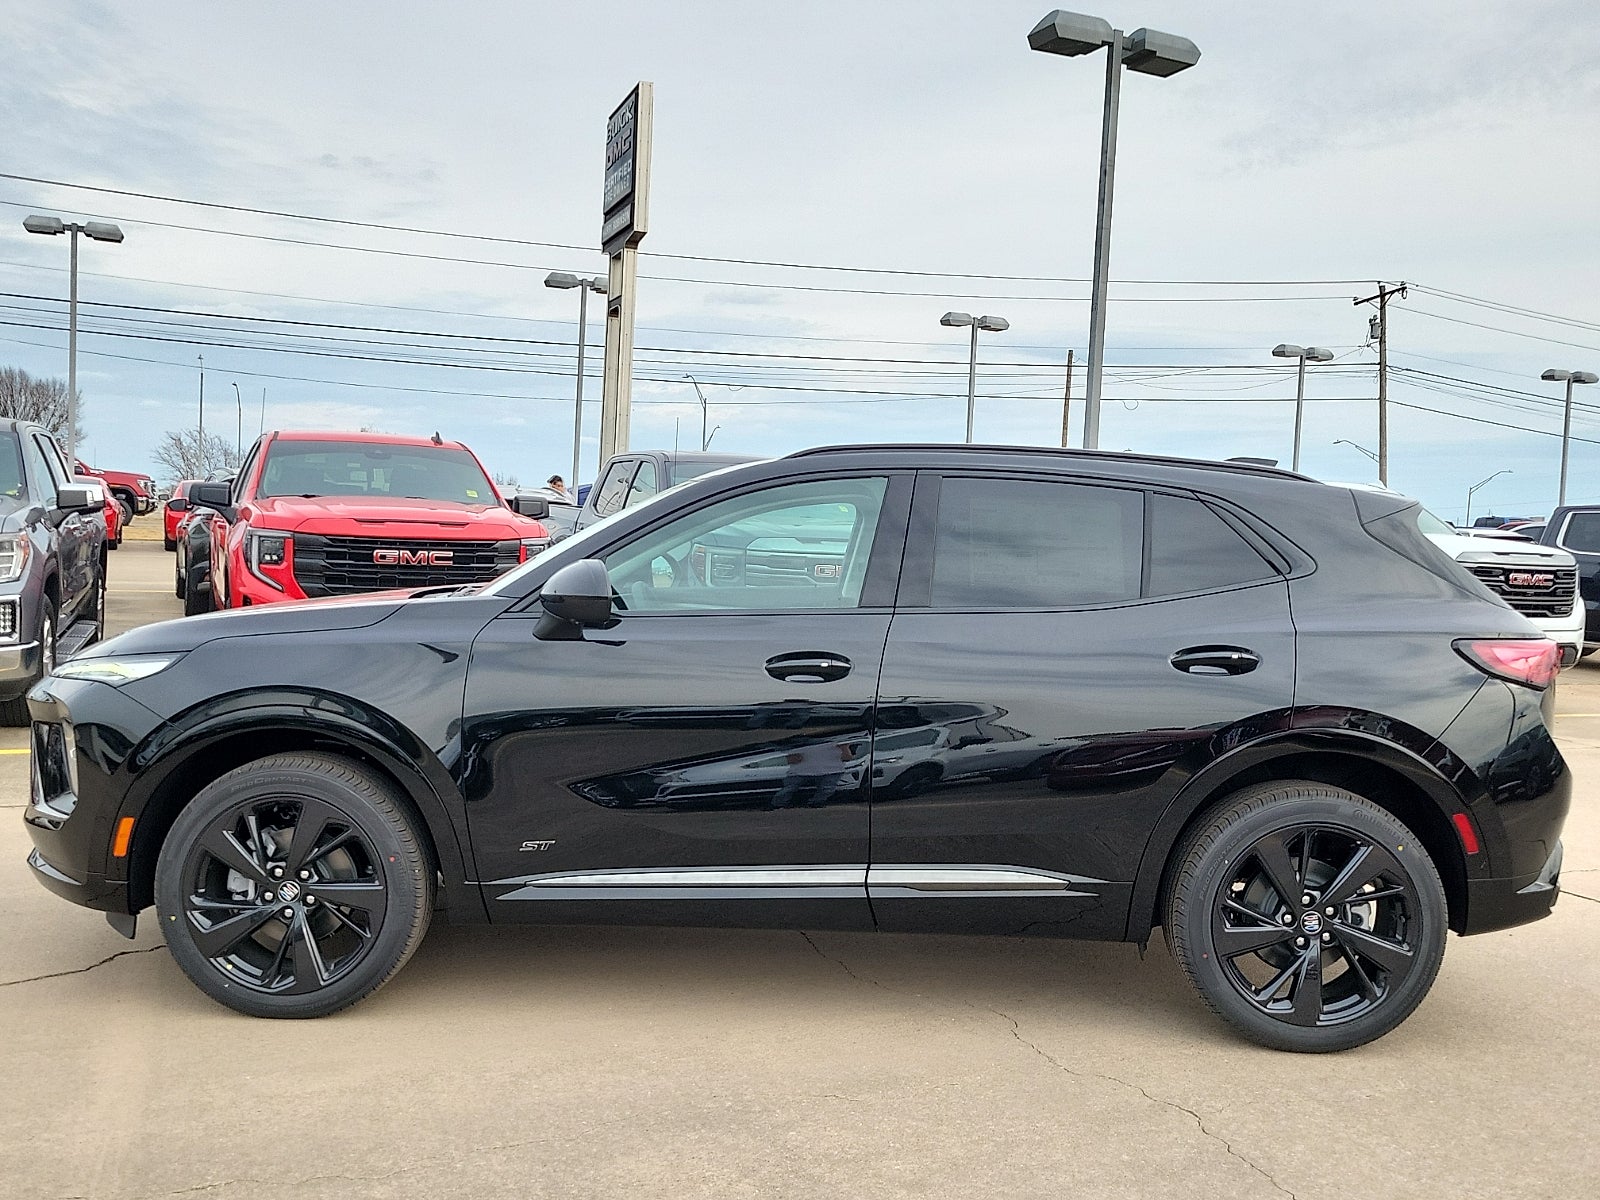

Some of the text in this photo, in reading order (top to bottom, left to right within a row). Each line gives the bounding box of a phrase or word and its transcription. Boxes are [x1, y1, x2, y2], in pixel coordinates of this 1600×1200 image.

[606, 100, 635, 145] BUICK
[606, 128, 632, 170] GMC
[373, 549, 454, 566] GMC
[1509, 572, 1554, 586] GMC
[519, 840, 556, 851] ST
